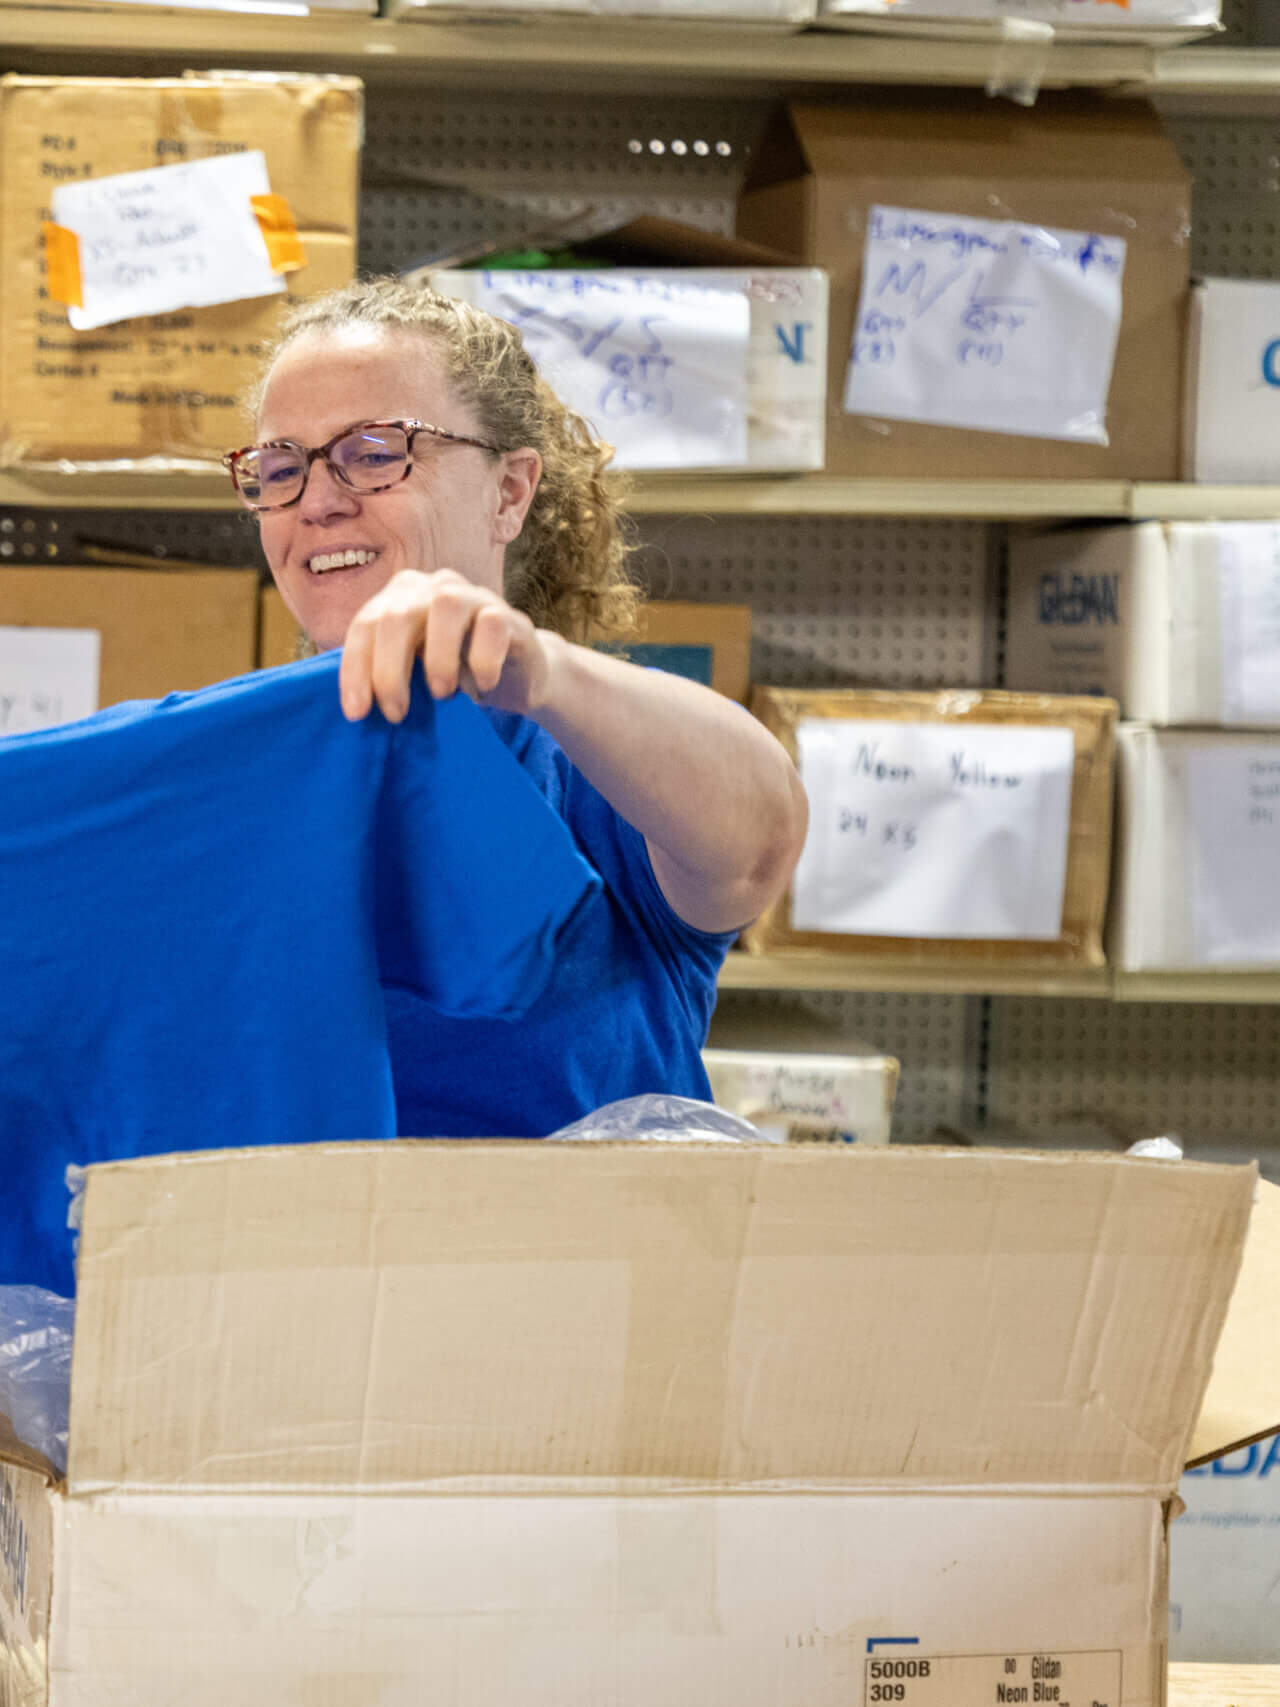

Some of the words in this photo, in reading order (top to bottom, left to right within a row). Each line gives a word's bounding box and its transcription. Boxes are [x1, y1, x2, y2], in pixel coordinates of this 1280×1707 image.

[949, 750, 1023, 790] Yellow
[870, 1660, 931, 1680] 5000B
[1031, 1656, 1062, 1680] Gildan
[870, 1683, 906, 1703] 309
[997, 1683, 1028, 1704] Neon
[1033, 1682, 1060, 1703] Blue
